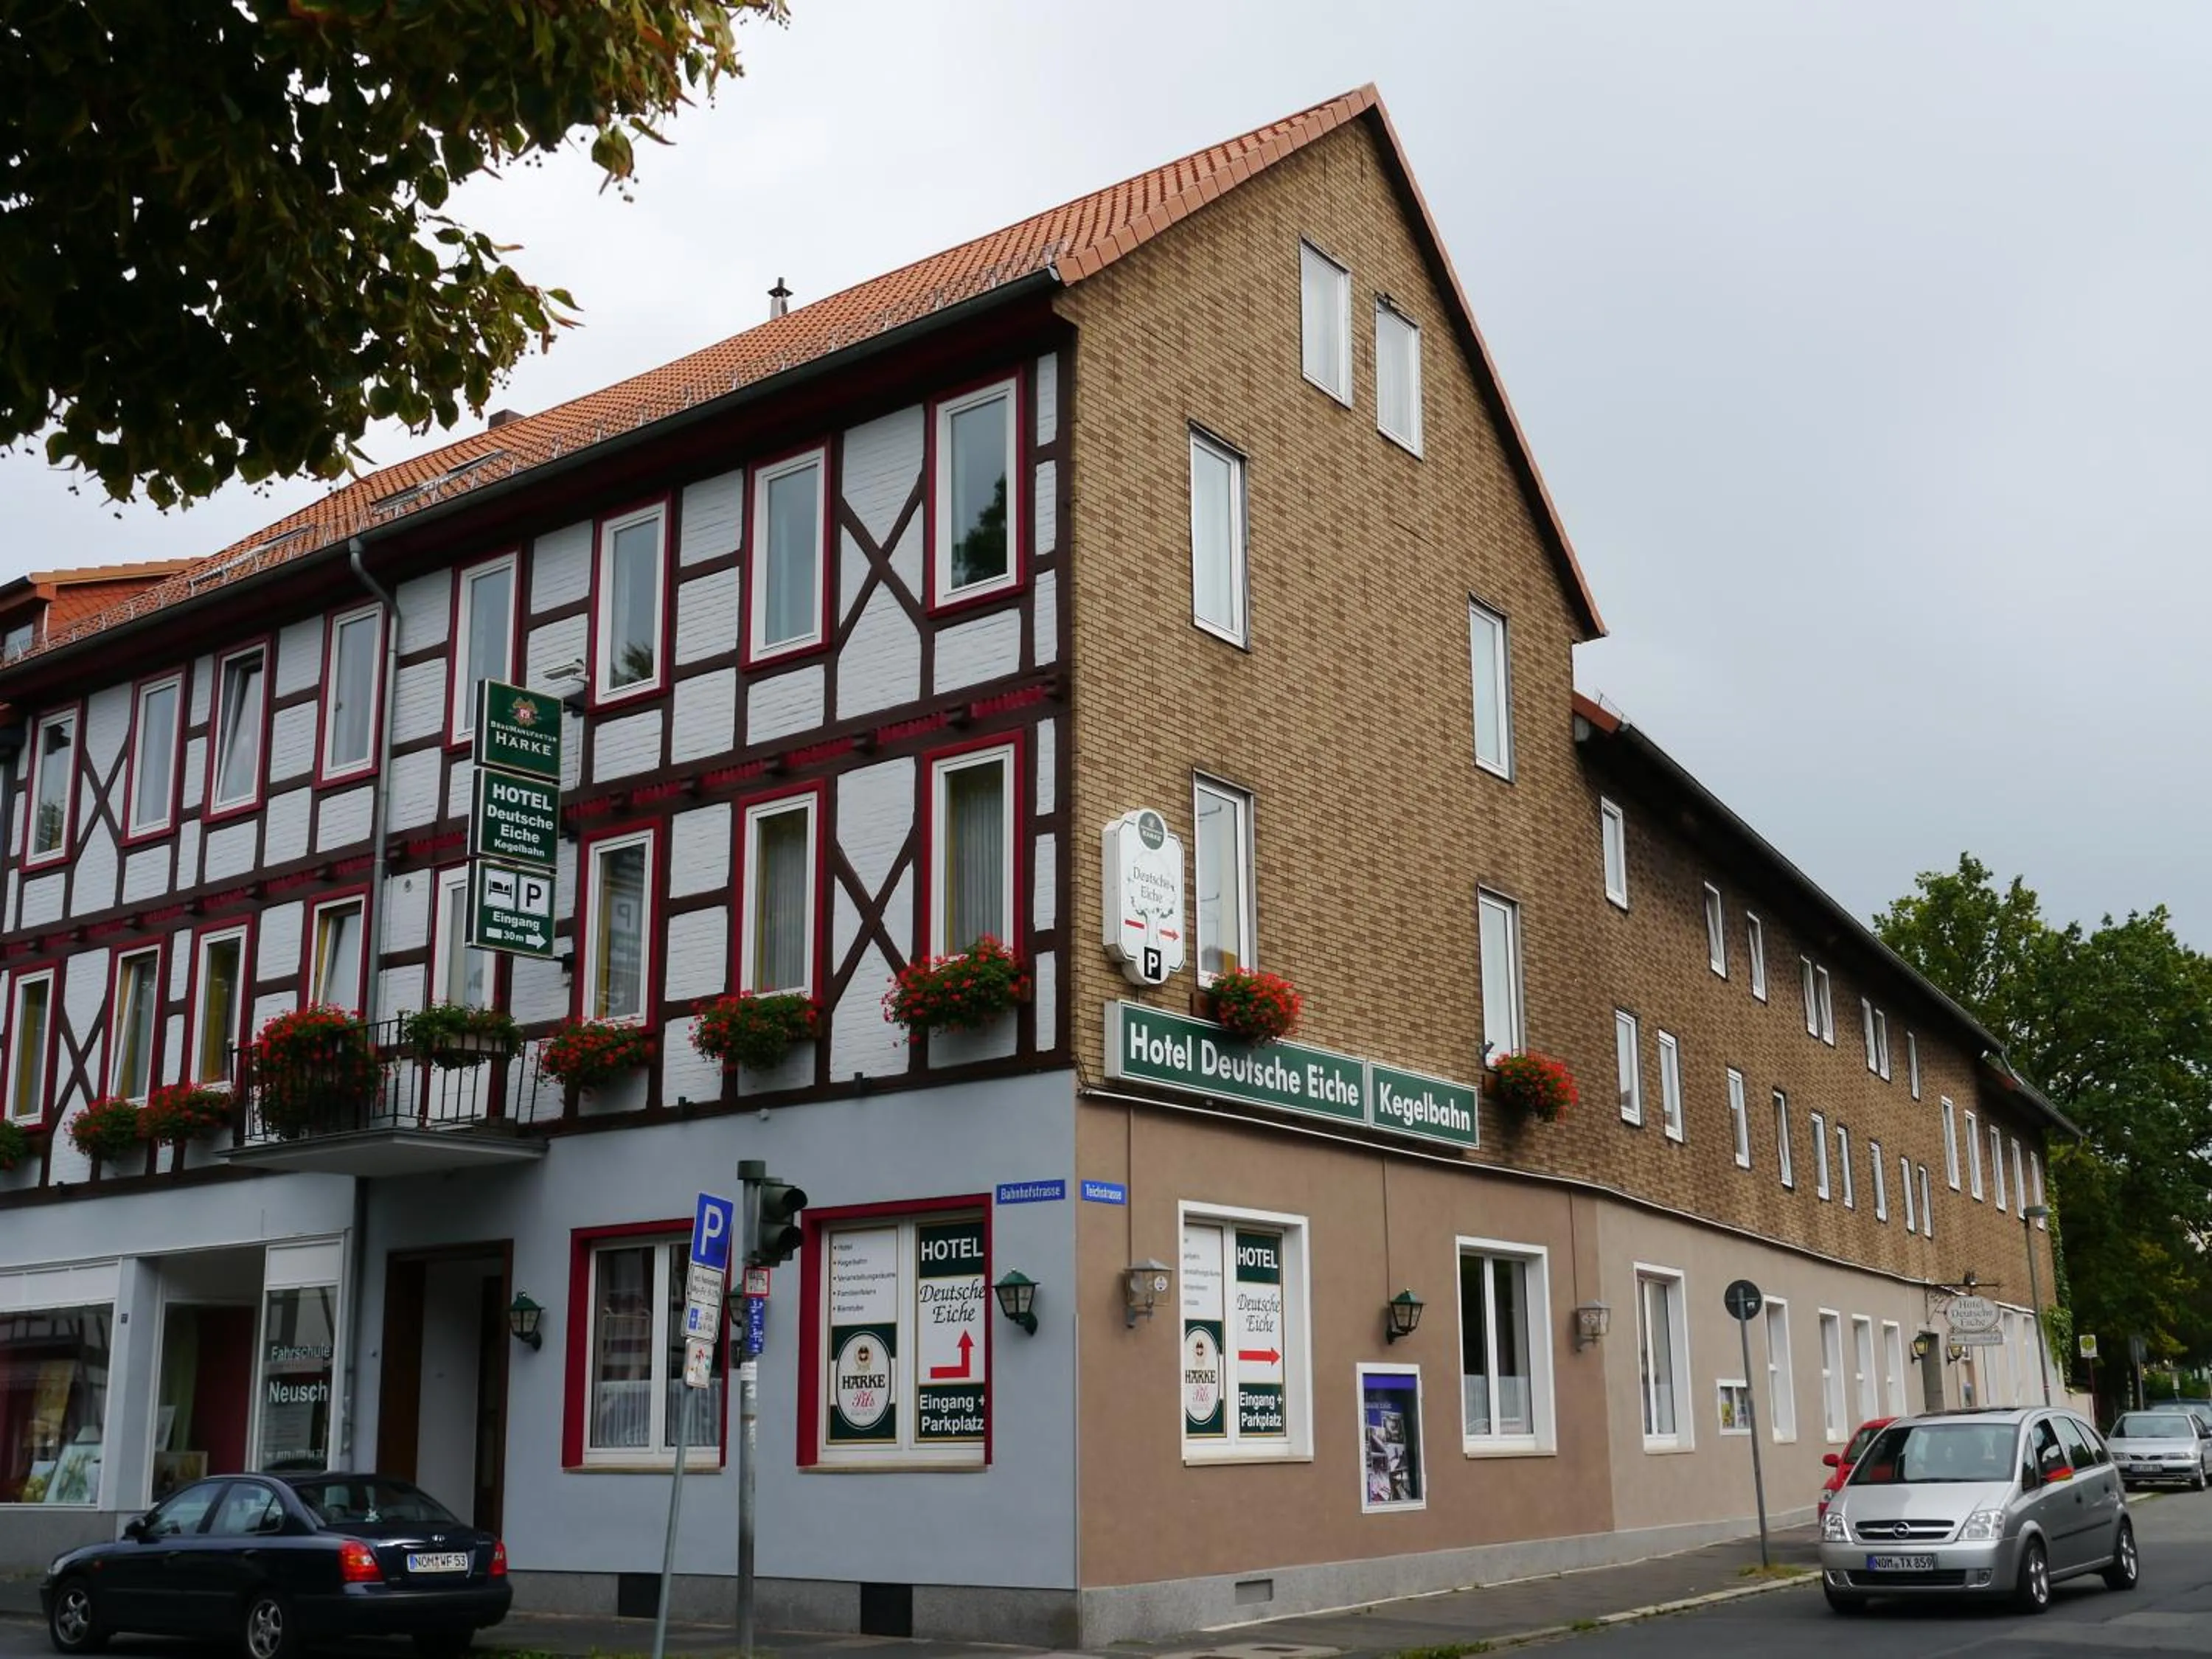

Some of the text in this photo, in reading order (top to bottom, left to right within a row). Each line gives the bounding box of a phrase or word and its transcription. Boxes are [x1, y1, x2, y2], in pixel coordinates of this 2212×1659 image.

[495, 730, 552, 756] HÄRKE
[493, 782, 553, 812] HOTEL
[487, 803, 554, 830] Deutsche
[501, 824, 540, 844] Eiche
[494, 838, 545, 858] Kegelbahn
[1133, 866, 1171, 889] Deutsche
[526, 883, 541, 908] P
[1141, 885, 1163, 904] Eiche
[493, 911, 540, 931] Eingang
[504, 930, 524, 942] 30 m
[1148, 951, 1158, 975] P
[1130, 1021, 1359, 1107] Hotel Deutsche Eiche
[1380, 1082, 1470, 1132] Kegelbahn
[1001, 1184, 1061, 1200] Bahnhofstrasse
[700, 1203, 723, 1256] P
[921, 1237, 984, 1262] HOTEL
[1237, 1246, 1278, 1268] HOTEL
[919, 1278, 985, 1303] Deutsche
[933, 1301, 975, 1324] Eiche
[1237, 1293, 1280, 1312] Deutsche
[1246, 1313, 1274, 1332] Eiche
[271, 1343, 331, 1363] Fahrschule
[268, 1380, 328, 1403] Neusch
[1239, 1391, 1275, 1410] Eingang
[919, 1394, 974, 1413] Eingang
[922, 1416, 984, 1435] Parkplatz
[1241, 1412, 1281, 1430] Parkplatz
[454, 1554, 467, 1567] 53
[1899, 1557, 1913, 1568] TX
[1914, 1557, 1932, 1568] 859
